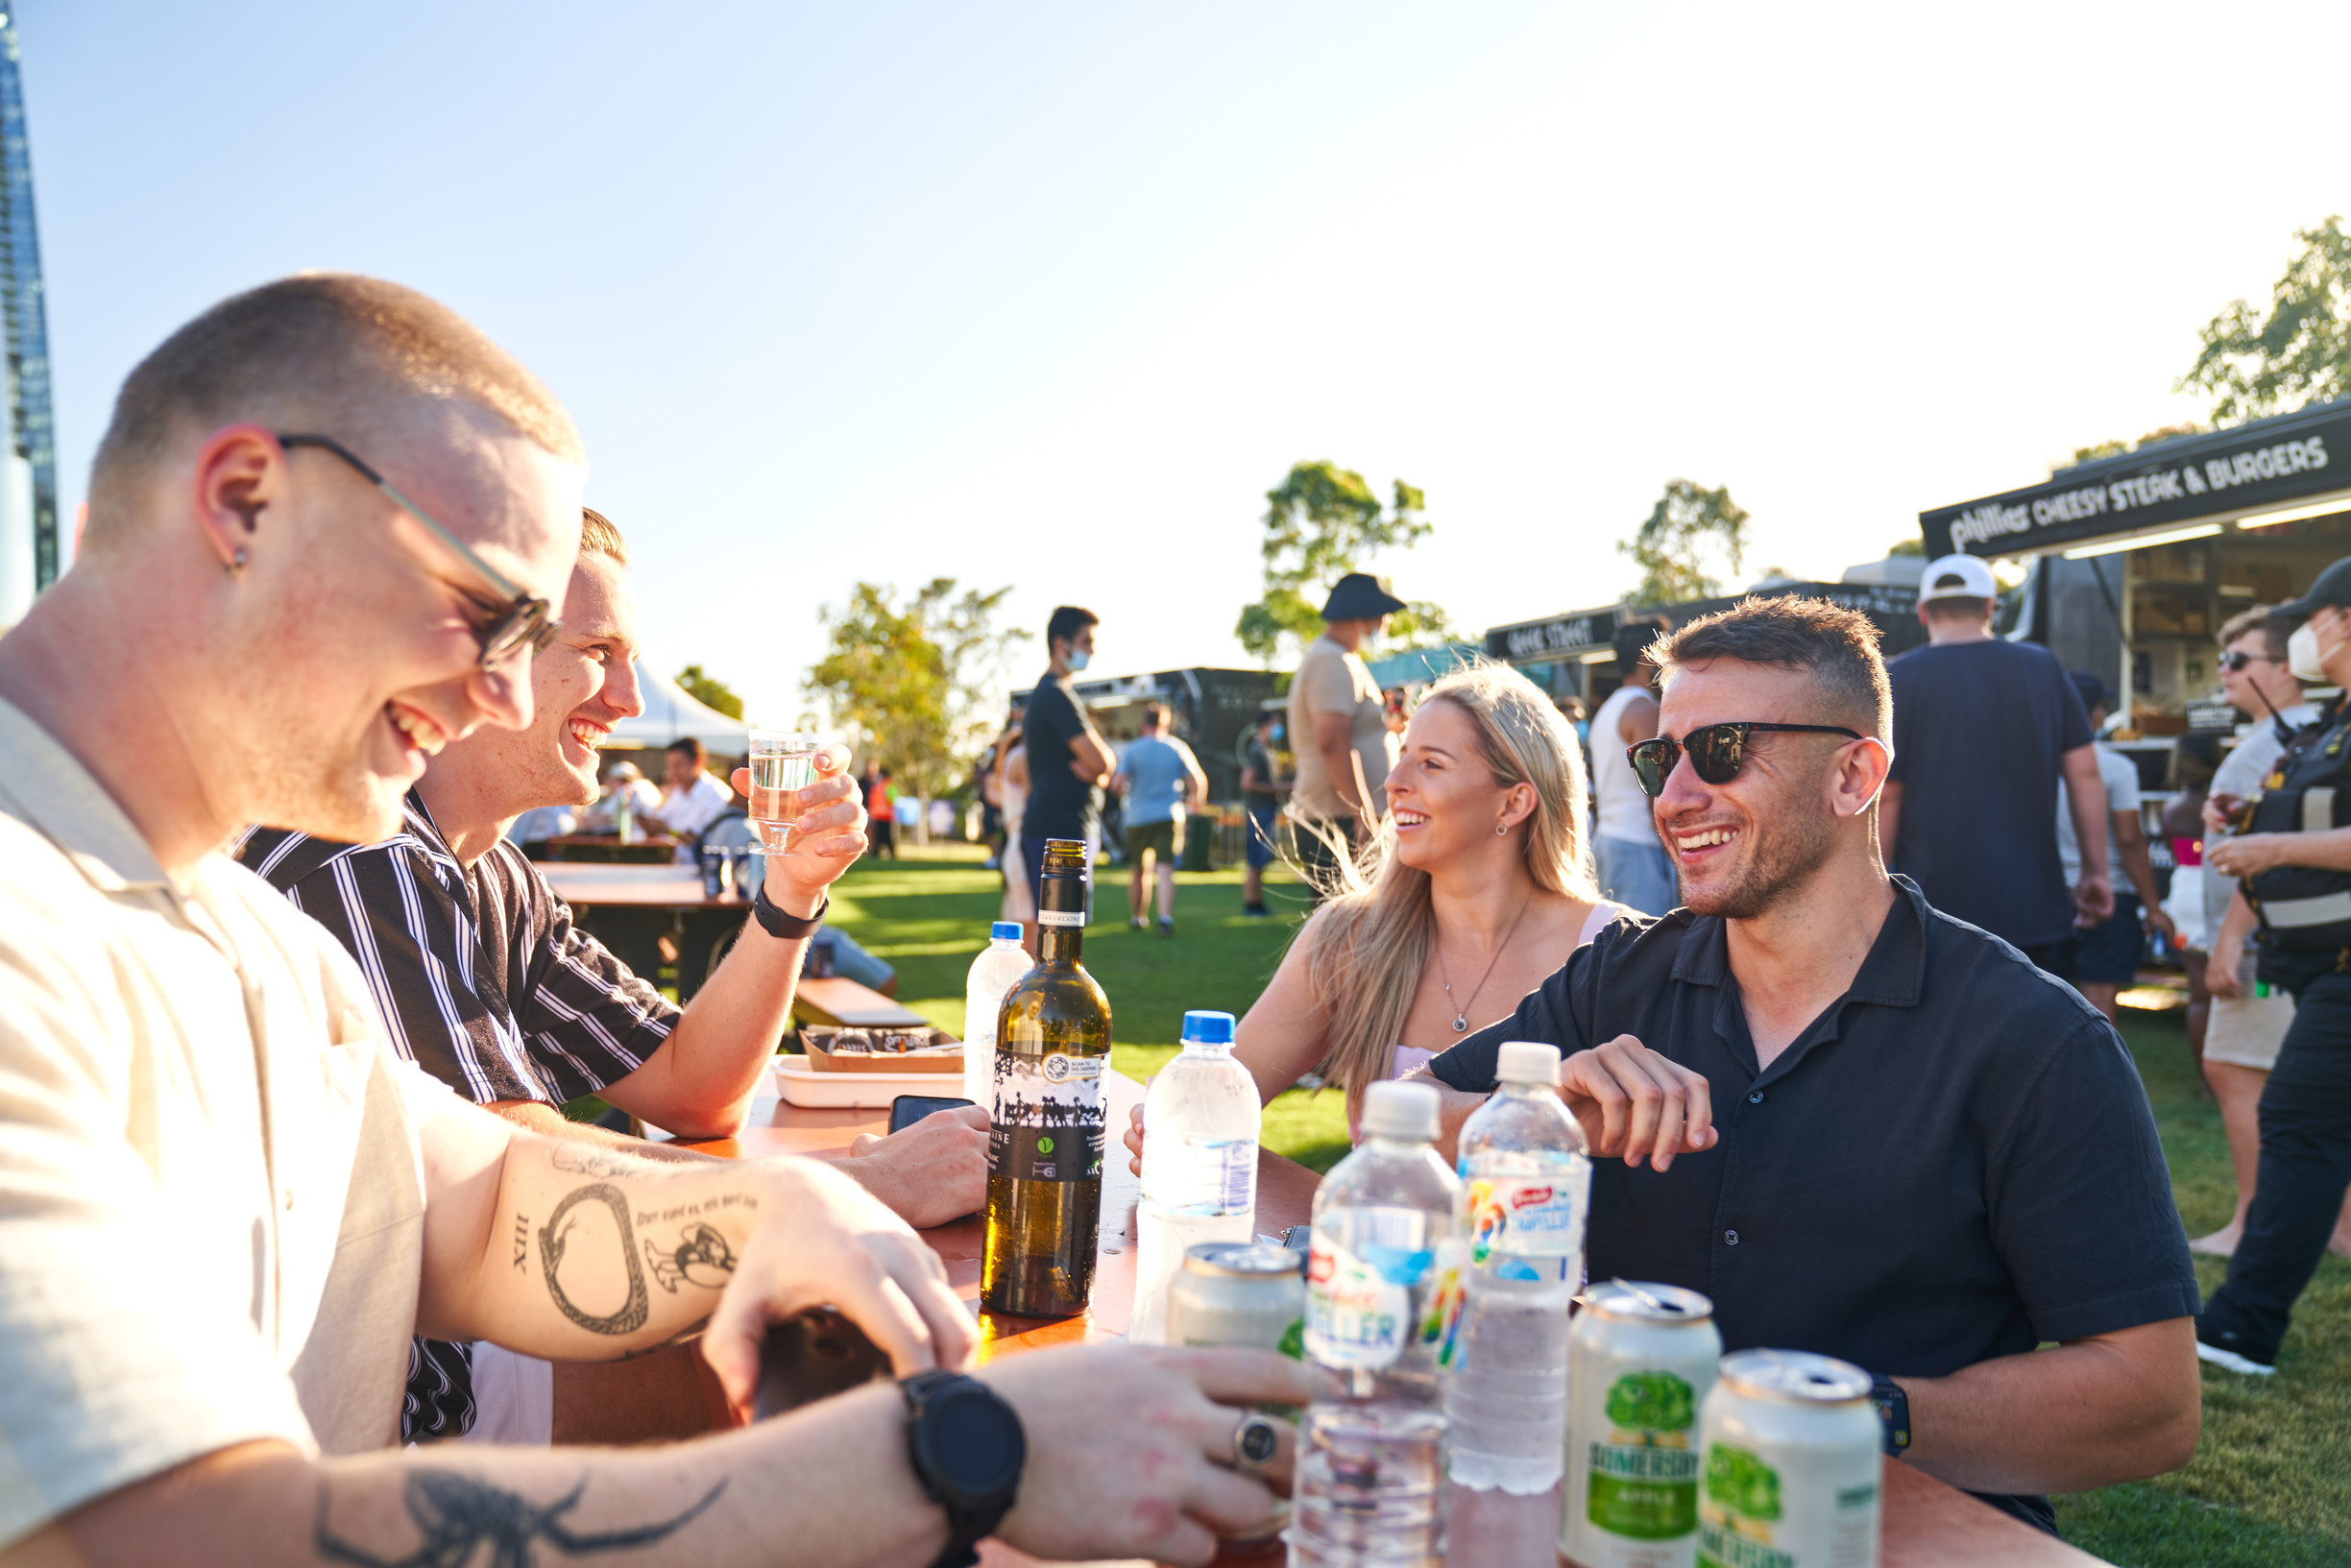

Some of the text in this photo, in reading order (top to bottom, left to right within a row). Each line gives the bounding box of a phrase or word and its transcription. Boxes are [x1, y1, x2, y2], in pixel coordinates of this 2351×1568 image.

[2031, 484, 2108, 526] CHEESY
[2108, 469, 2184, 512] STEAK
[2183, 466, 2208, 495] &
[2205, 435, 2329, 491] BURGERS
[513, 1213, 529, 1274] XIII
